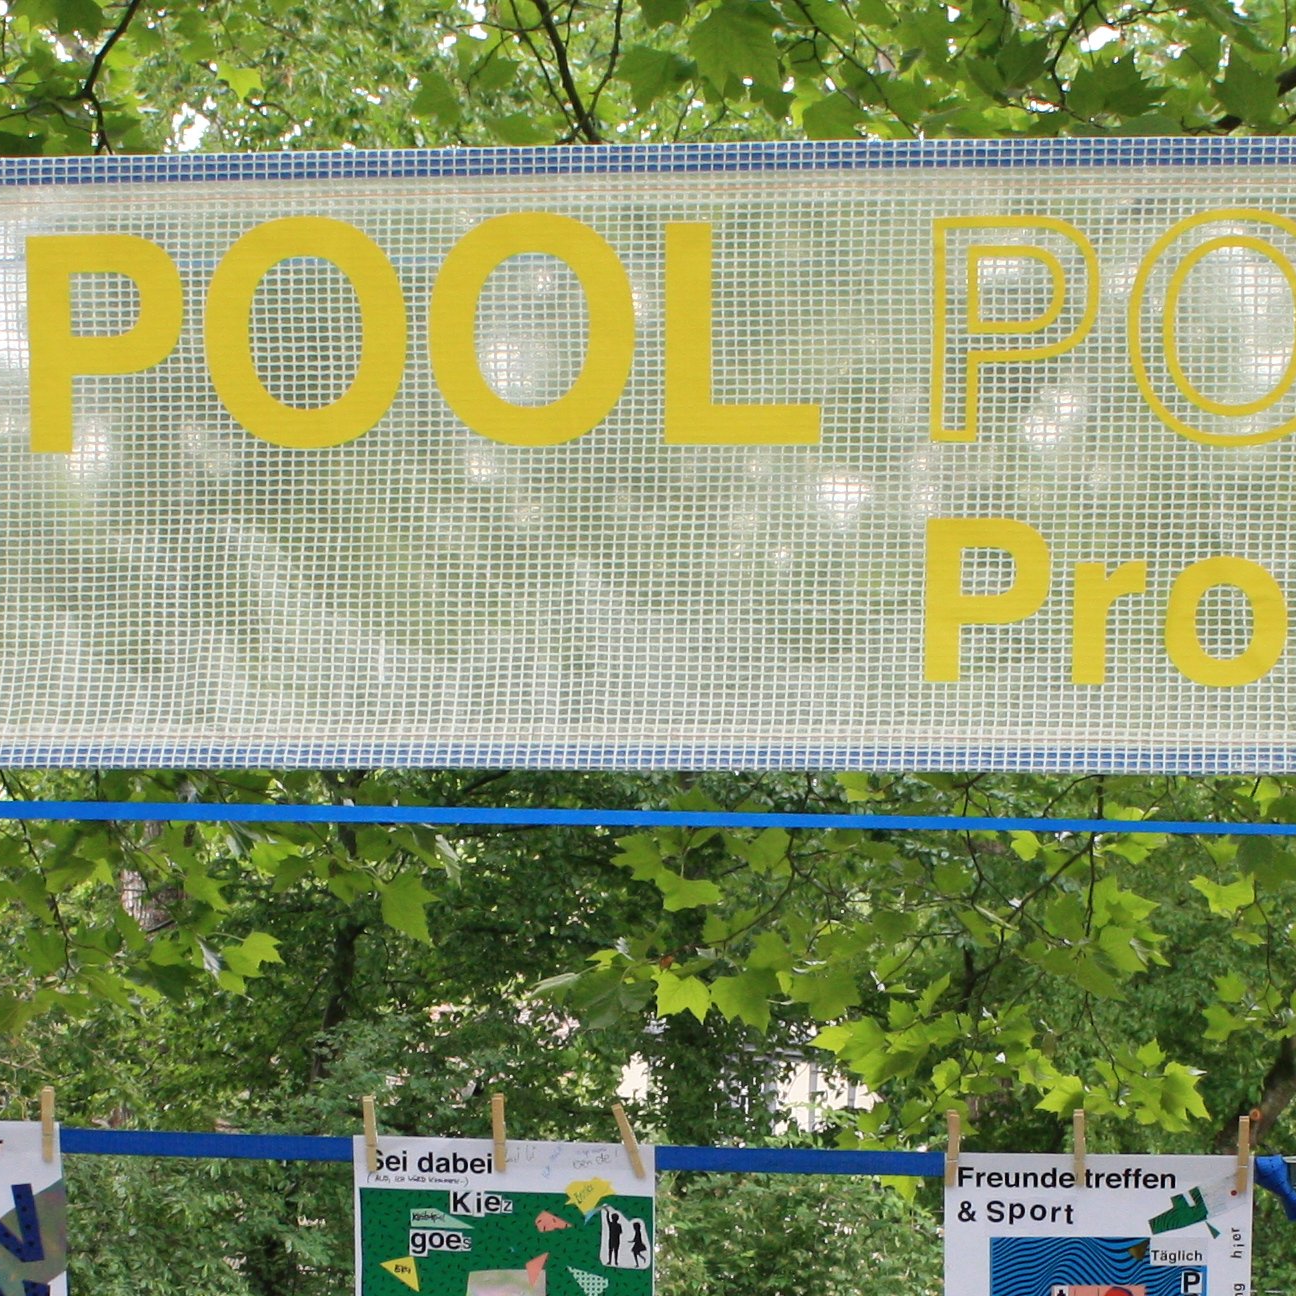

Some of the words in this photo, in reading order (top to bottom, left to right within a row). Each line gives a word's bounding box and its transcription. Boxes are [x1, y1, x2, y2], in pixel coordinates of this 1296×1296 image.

[26, 211, 822, 453] POOL
[375, 1151, 407, 1172] Sei
[418, 1151, 494, 1174] dabei
[957, 1166, 1075, 1188] Freunde
[1085, 1167, 1176, 1189] treffen
[452, 1191, 512, 1213] Kiez
[957, 1202, 976, 1222] &
[987, 1200, 1074, 1224] Sport
[410, 1231, 472, 1254] goes
[1230, 1227, 1244, 1259] hier
[1151, 1249, 1203, 1263] Täglich
